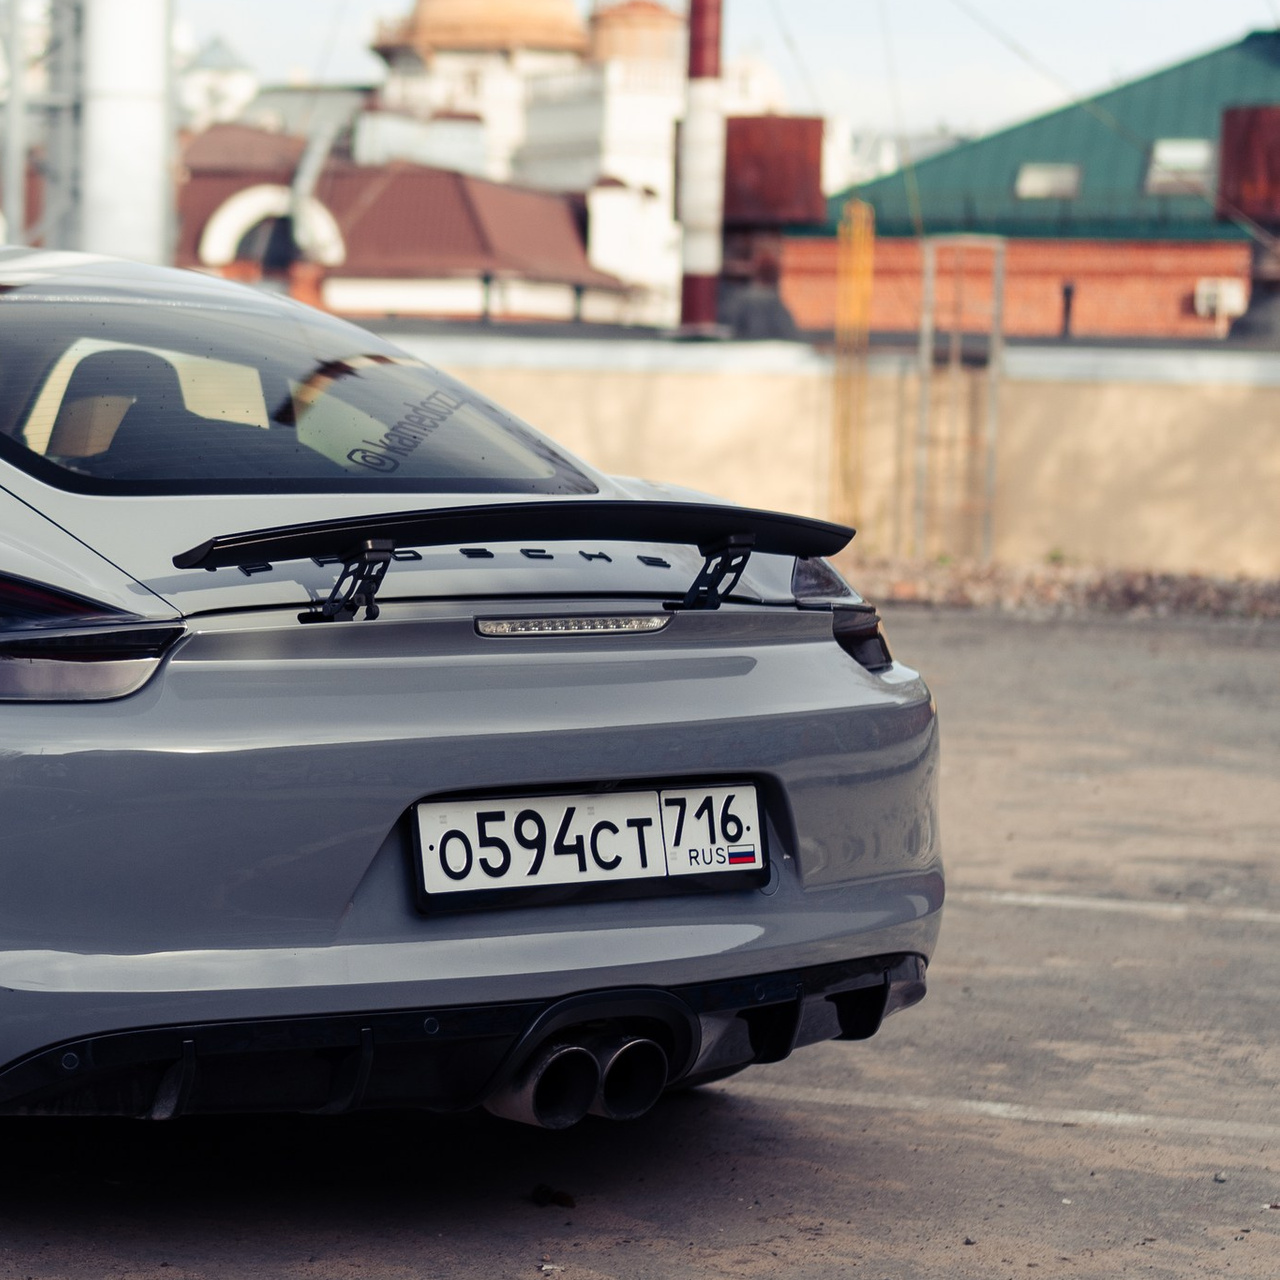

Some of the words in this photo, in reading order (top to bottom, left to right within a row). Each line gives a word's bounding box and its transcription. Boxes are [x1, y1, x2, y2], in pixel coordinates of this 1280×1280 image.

[362, 390, 466, 457] kamedozz
[663, 794, 744, 847] 716
[689, 847, 727, 867] RUS
